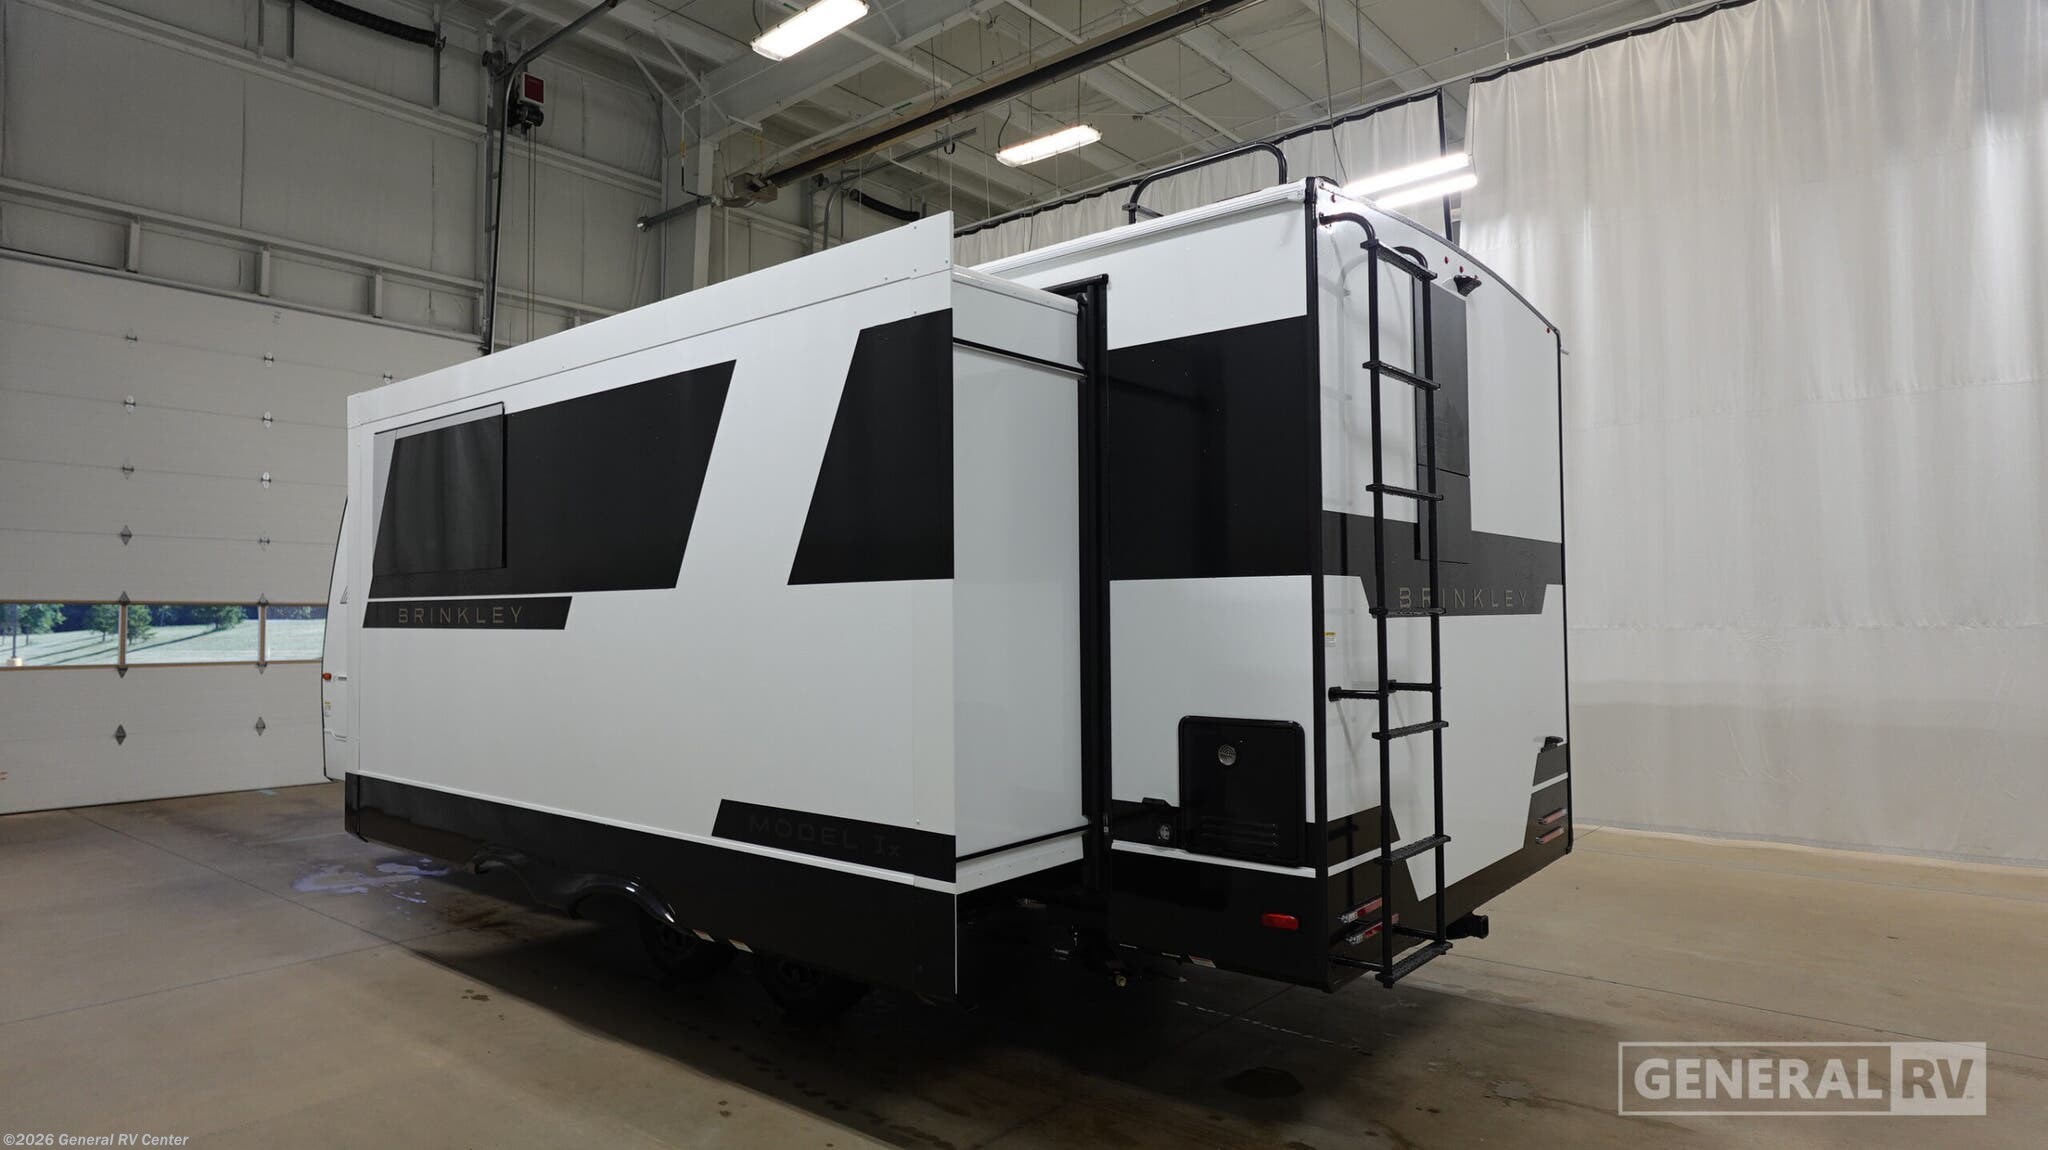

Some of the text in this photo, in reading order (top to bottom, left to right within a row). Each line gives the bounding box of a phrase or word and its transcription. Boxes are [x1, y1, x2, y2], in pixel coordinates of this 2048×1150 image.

[1398, 586, 1528, 609] BRINKLEY
[398, 606, 523, 624] BRINKLEY
[749, 815, 858, 849] MODEL
